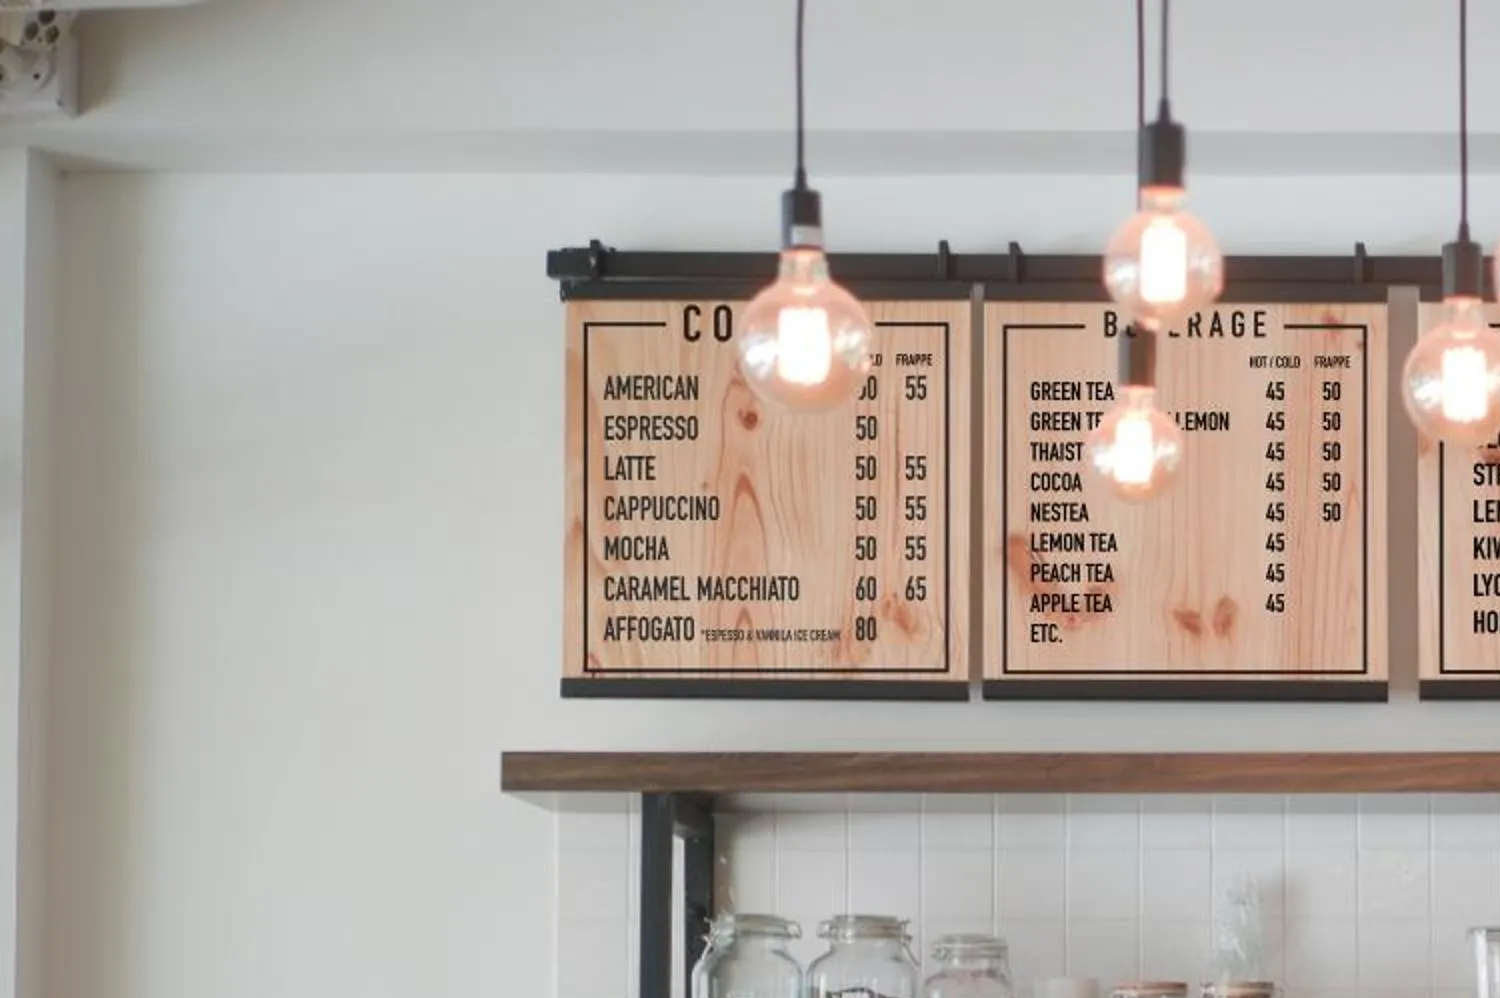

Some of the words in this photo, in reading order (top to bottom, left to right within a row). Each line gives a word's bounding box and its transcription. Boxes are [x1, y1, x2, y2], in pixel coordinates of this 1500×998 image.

[1104, 311, 1267, 337] BRAGE
[896, 354, 932, 366] FRAPPE
[1315, 356, 1350, 368] FRAPPE
[604, 376, 698, 400] AMERICAN
[906, 376, 926, 400] 55
[1031, 382, 1080, 400] GREEN
[1086, 382, 1114, 400] TEA
[1266, 382, 1284, 400] 45
[1323, 382, 1340, 400] 50
[605, 416, 698, 440] ESPRESSO
[856, 416, 877, 440] 50
[1031, 412, 1080, 430] GREEN
[1266, 412, 1284, 431] 45
[1323, 412, 1340, 431] 50
[1266, 442, 1284, 461] 45
[1323, 442, 1340, 461] 50
[605, 456, 655, 480] LATTE
[856, 456, 876, 480] 50
[906, 456, 926, 480] 55
[1031, 472, 1082, 491] COCOA
[1266, 472, 1284, 491] 45
[1323, 473, 1340, 491] 50
[604, 496, 719, 520] CAPPUCCINO
[856, 496, 876, 520] 50
[906, 496, 926, 520] 55
[1031, 503, 1088, 522] NESTEA
[1266, 503, 1284, 522] 45
[1323, 503, 1340, 521] 50
[605, 536, 669, 560] MOCHA
[856, 536, 876, 560] 50
[906, 536, 926, 560] 55
[1031, 533, 1084, 553] LEMON
[1089, 533, 1117, 552] TEA
[1266, 533, 1284, 552] 45
[1031, 563, 1080, 582] PEACH
[1086, 563, 1114, 582] TEA
[1266, 564, 1284, 582] 45
[605, 576, 690, 601] CARAMEL
[698, 576, 799, 601] MACCHIATO
[856, 576, 876, 601] 60
[906, 576, 926, 601] 65
[1030, 593, 1080, 612] APPLE
[1084, 594, 1112, 612] TEA
[1266, 594, 1284, 612] 45
[604, 616, 694, 641] AFFOGATO
[856, 616, 876, 641] 80
[1031, 624, 1062, 642] ETC.
